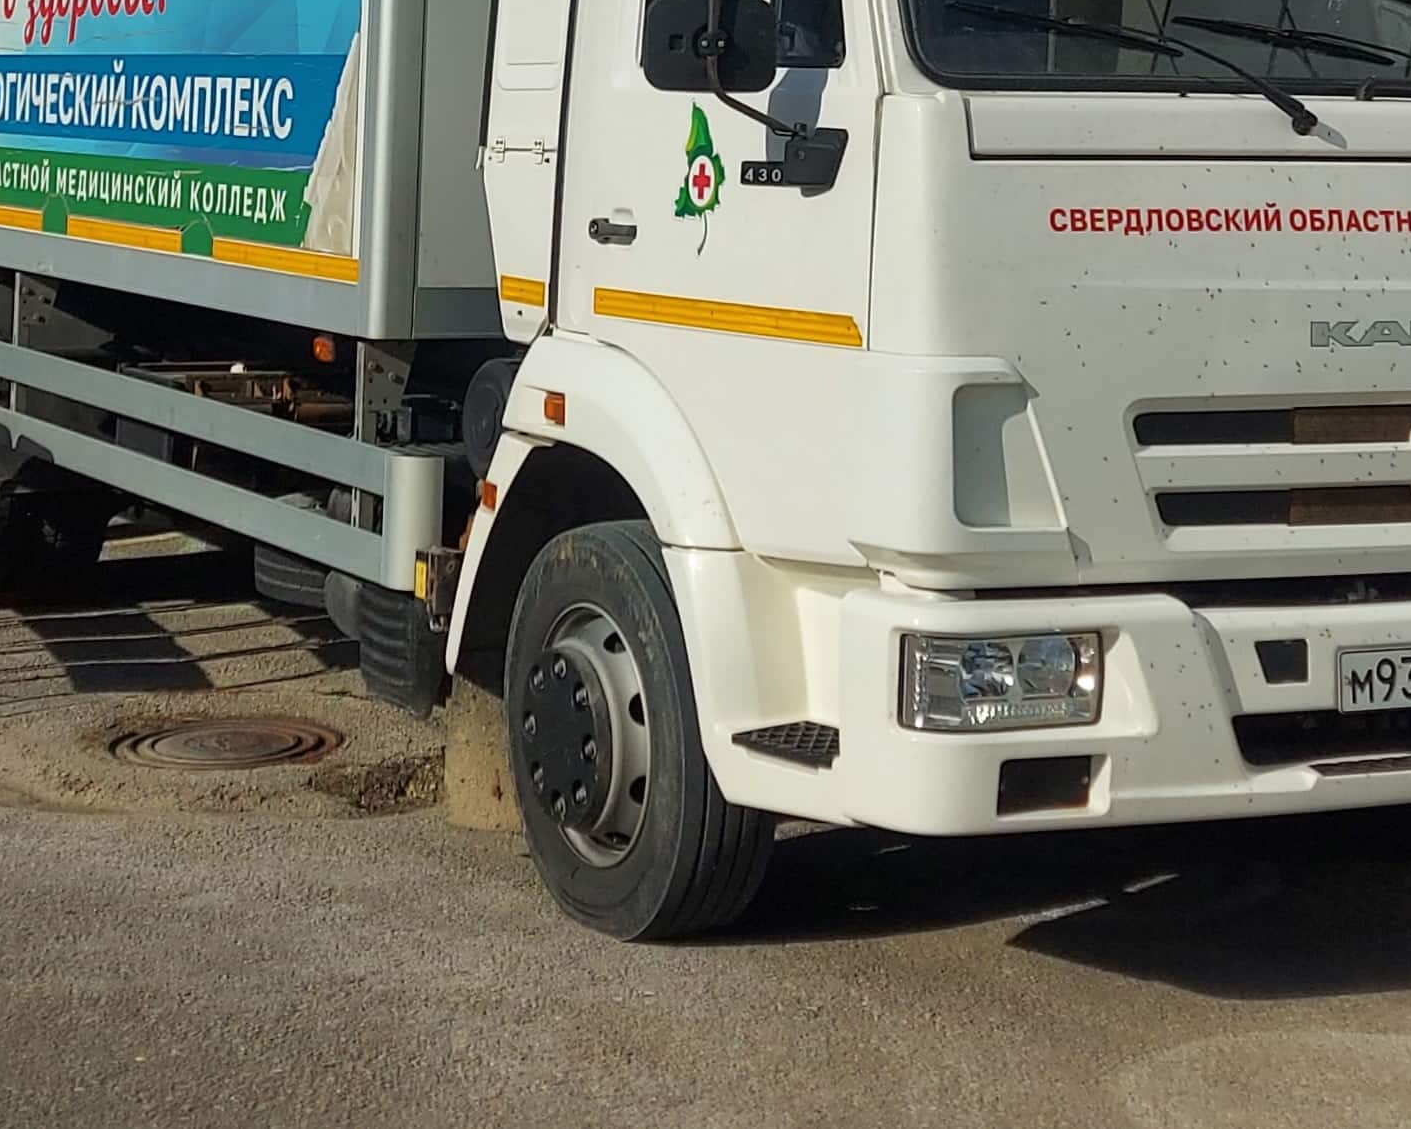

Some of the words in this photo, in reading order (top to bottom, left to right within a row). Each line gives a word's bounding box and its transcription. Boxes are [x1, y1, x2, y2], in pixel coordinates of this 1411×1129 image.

[131, 74, 294, 140] КОМПЛЕКС
[56, 167, 182, 209] МЕДИЦИНСКИЙ
[190, 180, 287, 225] КОЛЛЕДЖ
[744, 167, 782, 182] 430
[1048, 202, 1283, 236] СВЕРДЛОВСКИЙ
